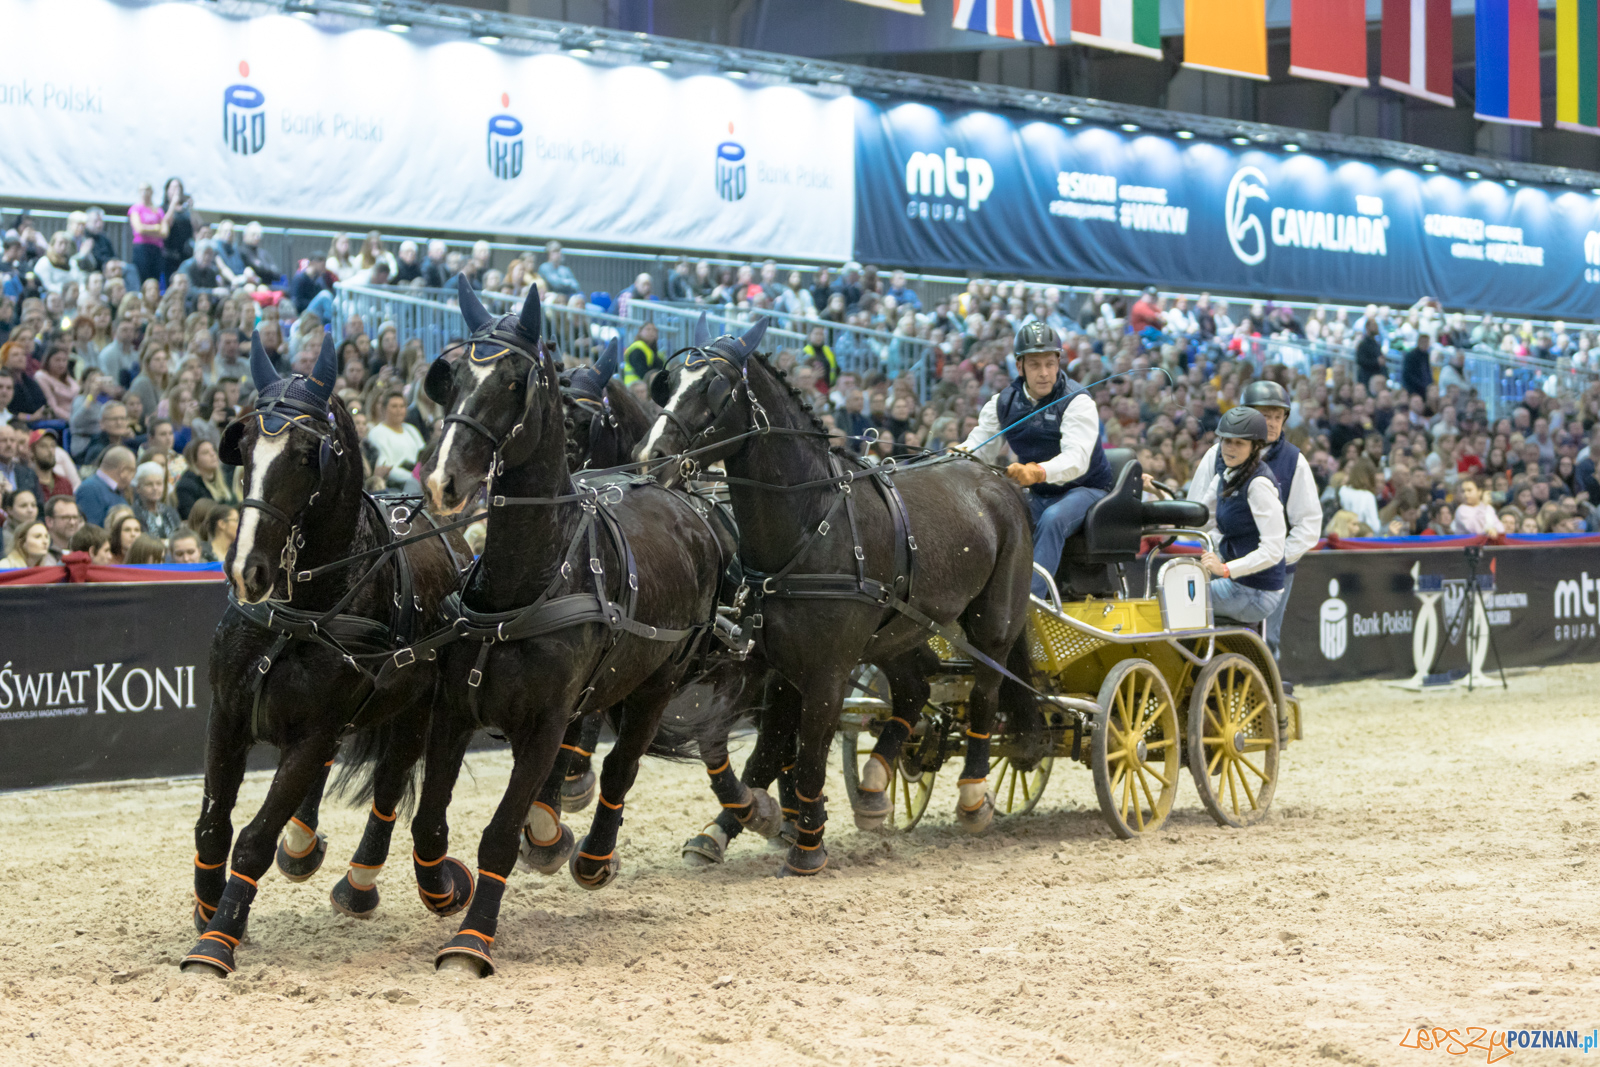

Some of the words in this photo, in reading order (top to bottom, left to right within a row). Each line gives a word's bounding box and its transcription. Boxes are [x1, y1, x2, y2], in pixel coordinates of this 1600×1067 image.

[0, 78, 34, 107] ank
[43, 81, 102, 113] Polski
[281, 107, 326, 137] Bank
[333, 112, 384, 143] Polski
[536, 135, 576, 162] Bank
[581, 139, 626, 167] Polski
[906, 146, 994, 211] mtp
[906, 200, 966, 222] GRUPA
[1554, 571, 1600, 626] mt
[1353, 612, 1380, 637] Bank
[1382, 609, 1413, 635] Polski
[1554, 623, 1596, 641] GRUPA
[0, 661, 91, 709] ŚWIAT
[94, 662, 197, 714] KONI
